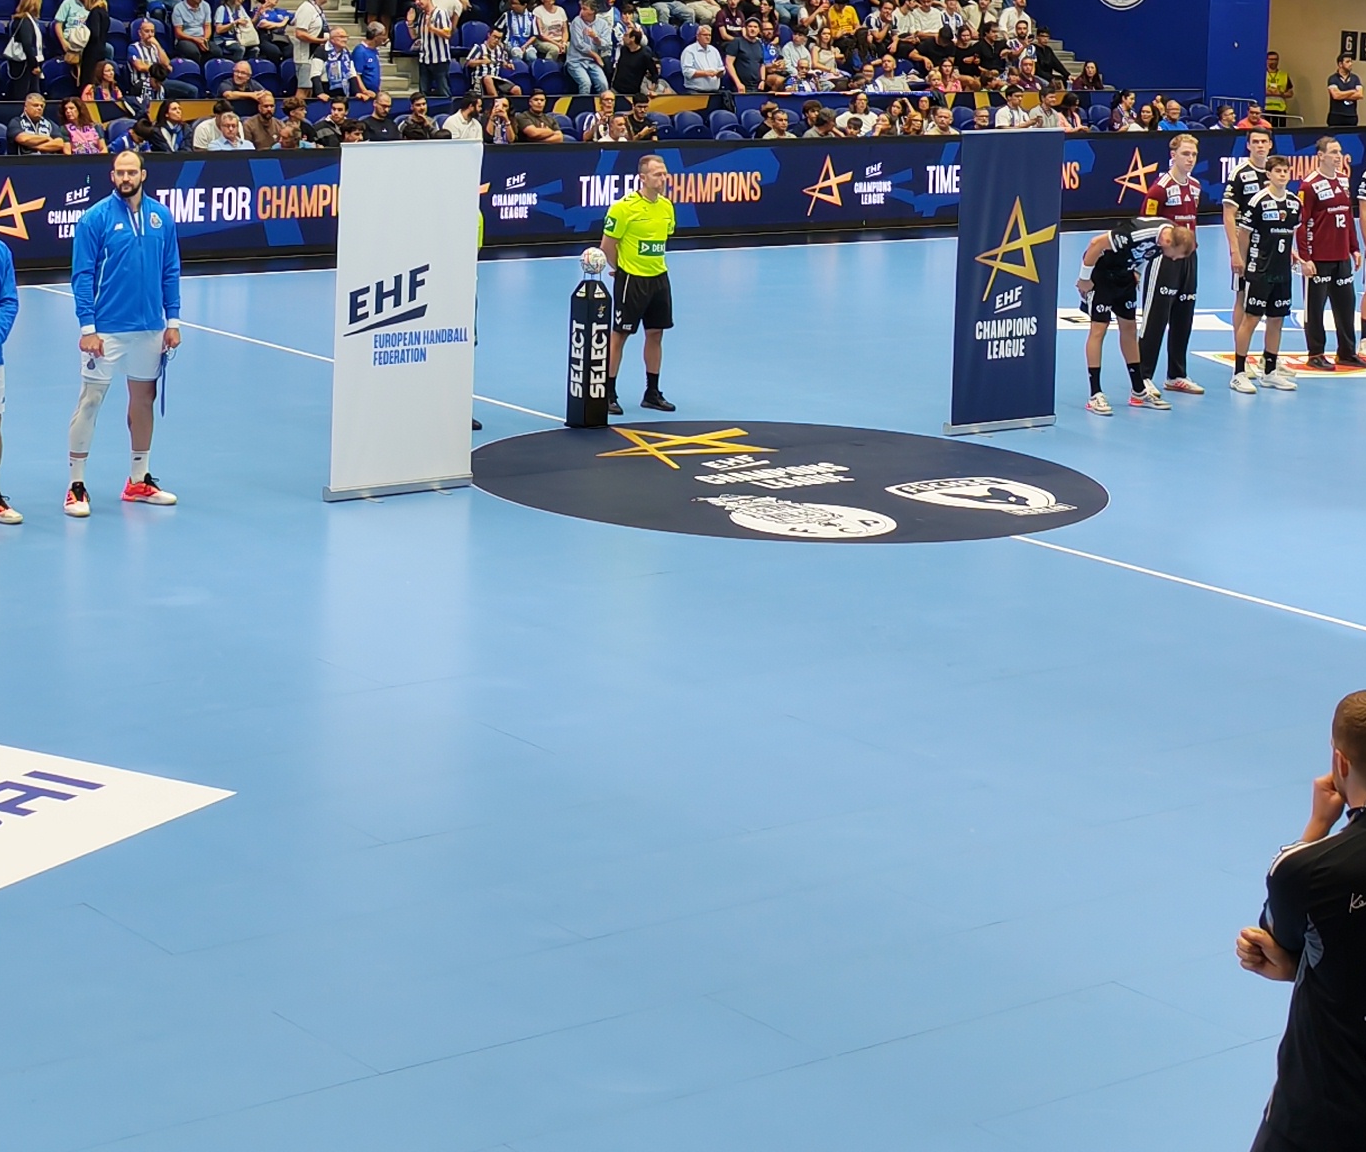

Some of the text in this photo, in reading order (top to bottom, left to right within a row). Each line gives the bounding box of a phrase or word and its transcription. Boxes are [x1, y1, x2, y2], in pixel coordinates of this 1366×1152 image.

[1345, 35, 1353, 51] 6
[865, 162, 882, 176] EHF
[506, 173, 526, 187] EHF
[854, 180, 892, 194] CHAMPIONS
[927, 165, 961, 194] TIME
[65, 186, 91, 203] EHF
[580, 174, 619, 207] TIME
[667, 171, 762, 204] CHAMPIONS
[156, 184, 339, 223] TIME FOR CHAMPI
[492, 192, 537, 207] CHAMPIONS
[861, 193, 885, 205] LEAGUE
[500, 206, 528, 220] LEAGUE
[1335, 214, 1346, 228] 12
[58, 223, 76, 239] LEA
[1278, 239, 1285, 253] 6
[348, 264, 430, 325] EHF
[995, 285, 1023, 310] EHF
[975, 316, 1037, 340] CHAMPIONS
[373, 327, 468, 349] EUROPEAN HANDBALL
[373, 348, 427, 367] FEDERATION
[987, 339, 1025, 360] LEAGUE
[570, 320, 585, 398] SELECT
[589, 322, 608, 398] SELECT
